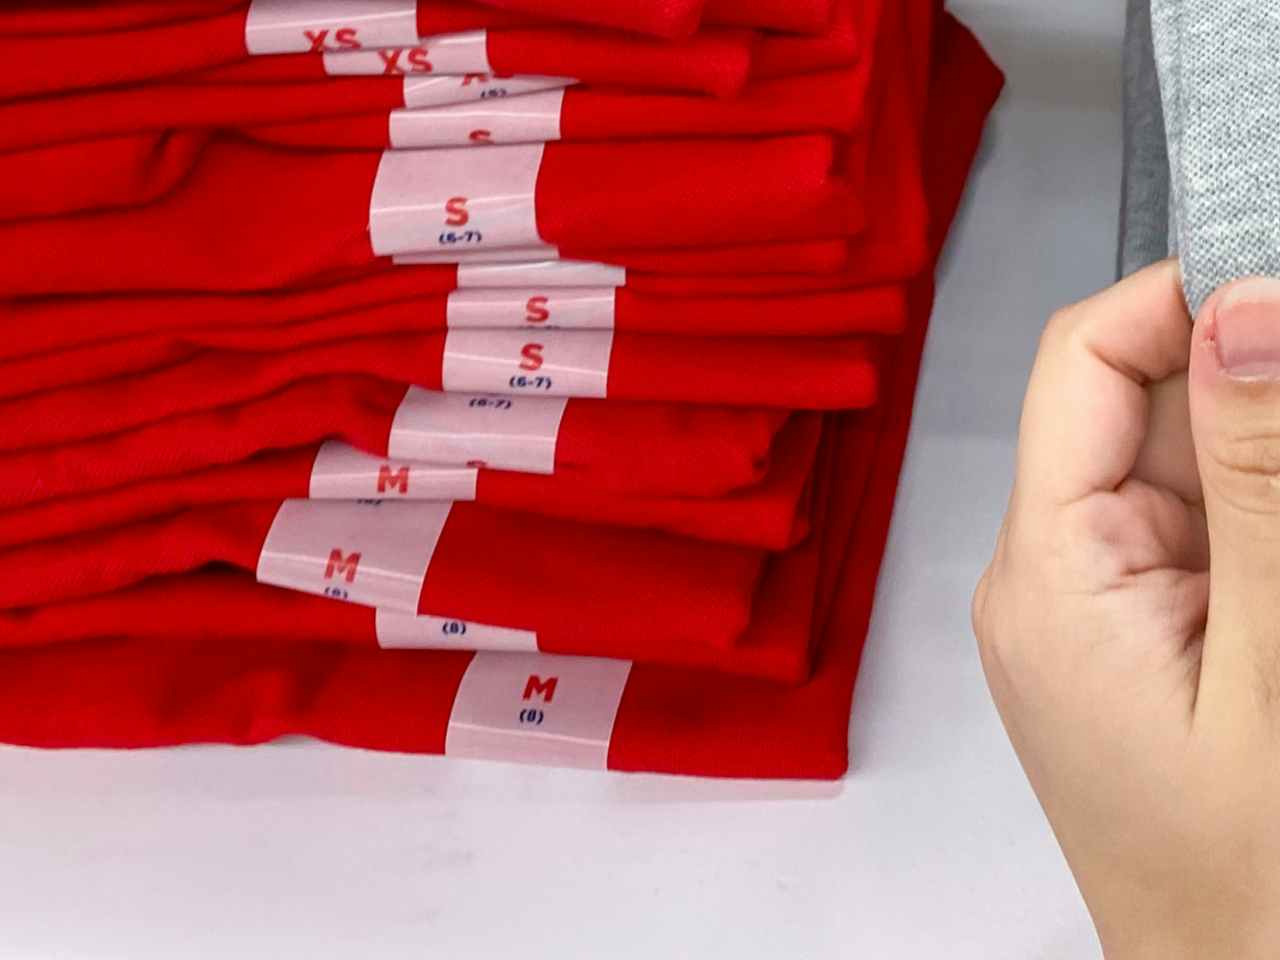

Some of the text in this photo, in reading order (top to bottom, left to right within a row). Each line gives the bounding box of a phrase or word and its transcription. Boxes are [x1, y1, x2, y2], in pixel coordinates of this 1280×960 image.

[303, 28, 362, 51] XS
[378, 47, 433, 74] XS
[444, 197, 469, 227] S
[438, 232, 482, 244] (6-7)
[525, 296, 549, 323] S
[519, 343, 544, 371] S
[509, 376, 552, 390] (6-7)
[377, 464, 410, 494] M
[324, 548, 361, 583] M
[523, 675, 558, 703] M
